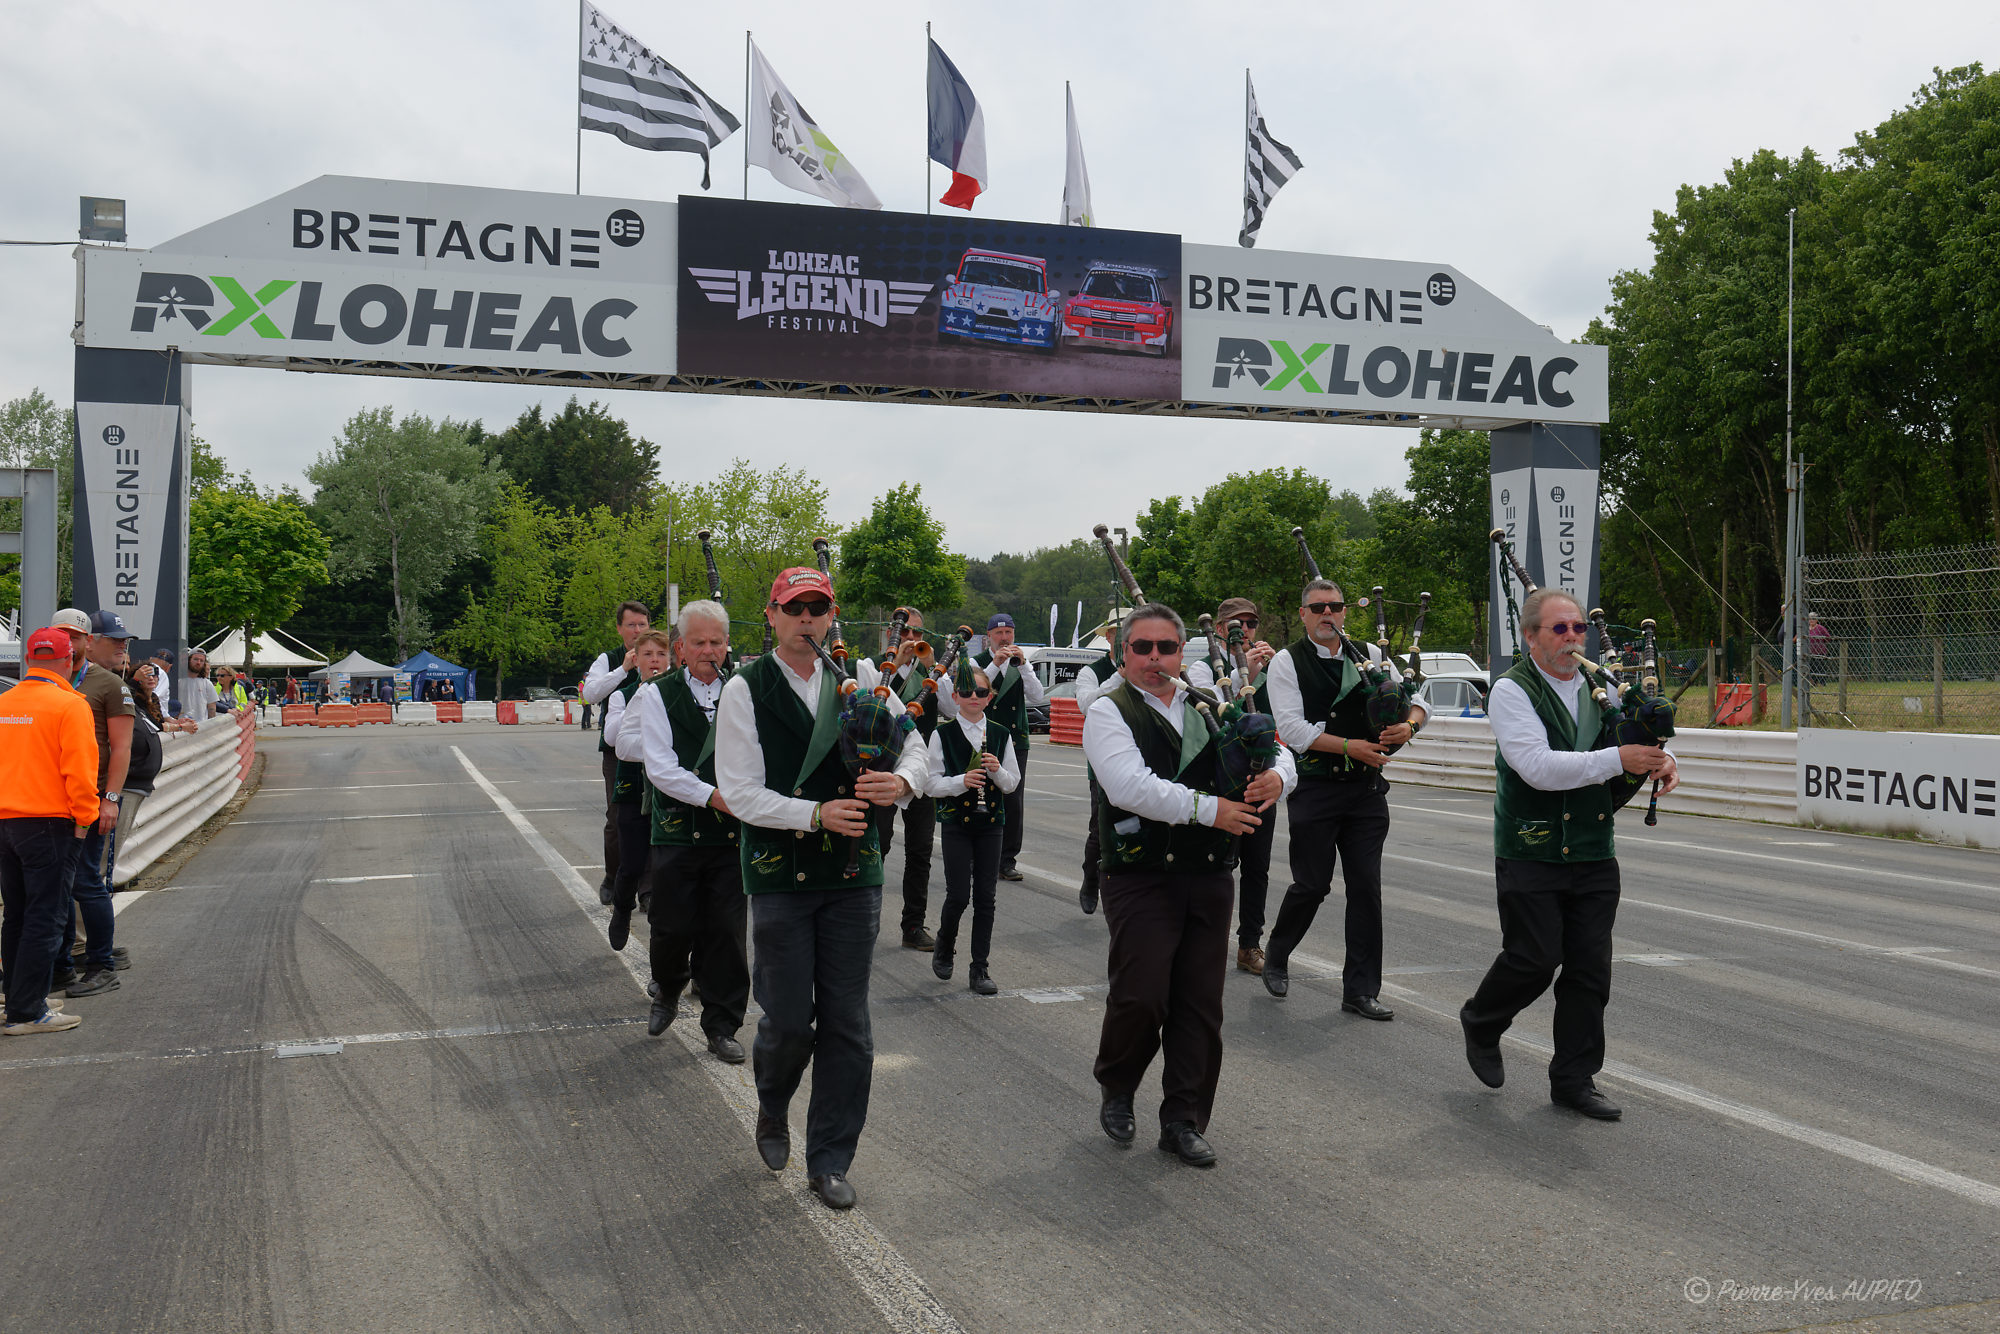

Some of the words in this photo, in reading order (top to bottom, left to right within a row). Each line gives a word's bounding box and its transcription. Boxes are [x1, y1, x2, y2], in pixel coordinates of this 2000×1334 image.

[293, 208, 600, 269] BRETAGNE
[768, 249, 859, 276] LOHEAC
[737, 271, 888, 328] LEGEND
[768, 314, 859, 334] FESTIVAL
[1189, 274, 1422, 325] BRETAGNE
[115, 448, 140, 607] BRETAGNE
[1805, 764, 1995, 816] BRETAGNE
